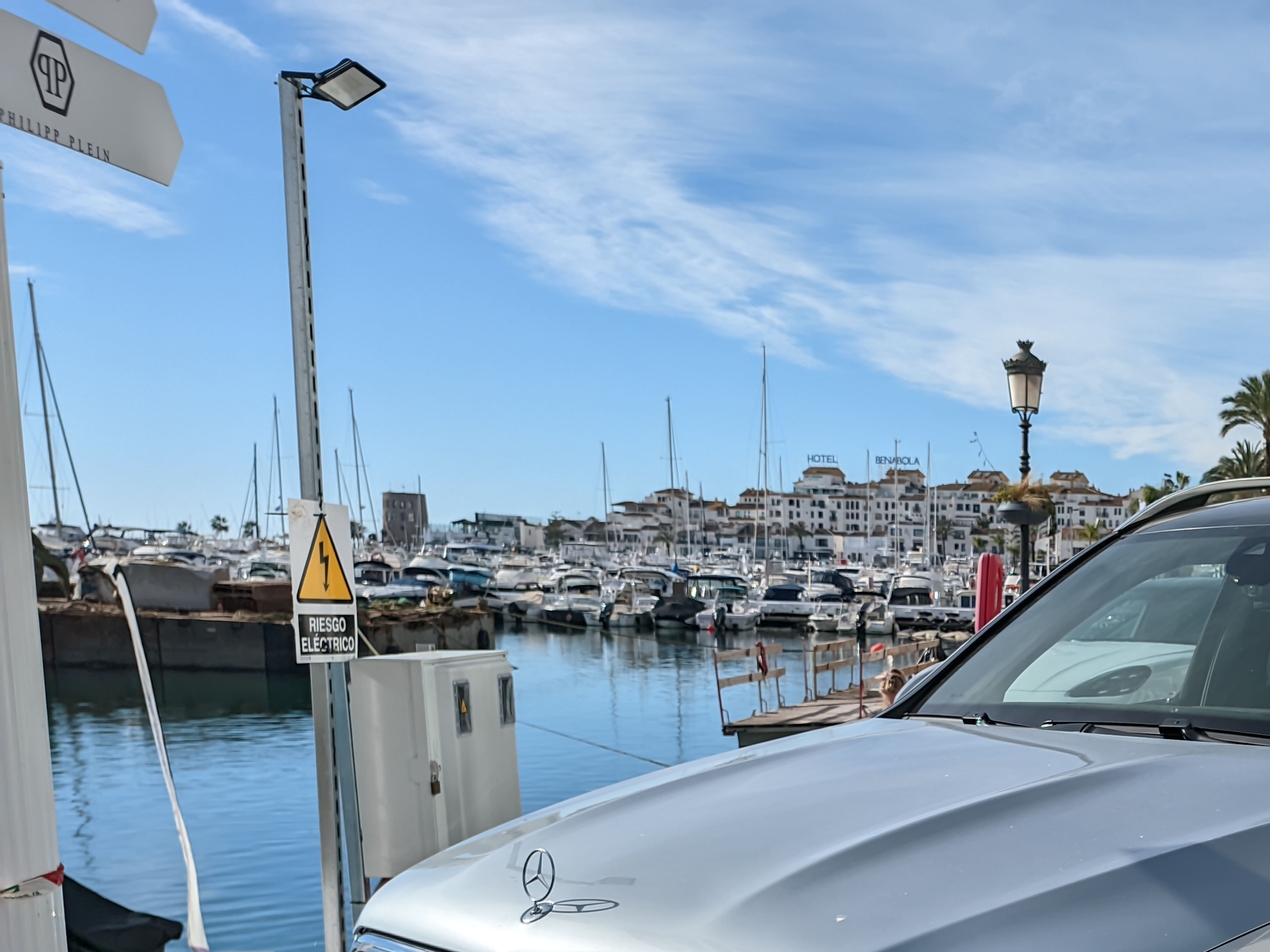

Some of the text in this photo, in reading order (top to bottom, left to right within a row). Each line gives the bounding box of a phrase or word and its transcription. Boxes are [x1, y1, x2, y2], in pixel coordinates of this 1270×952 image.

[69, 135, 110, 163] PLEIN
[807, 454, 920, 465] HOTEL BENABOLA
[308, 616, 347, 633] RIESGO
[301, 632, 355, 653] ELÉCTRICO
